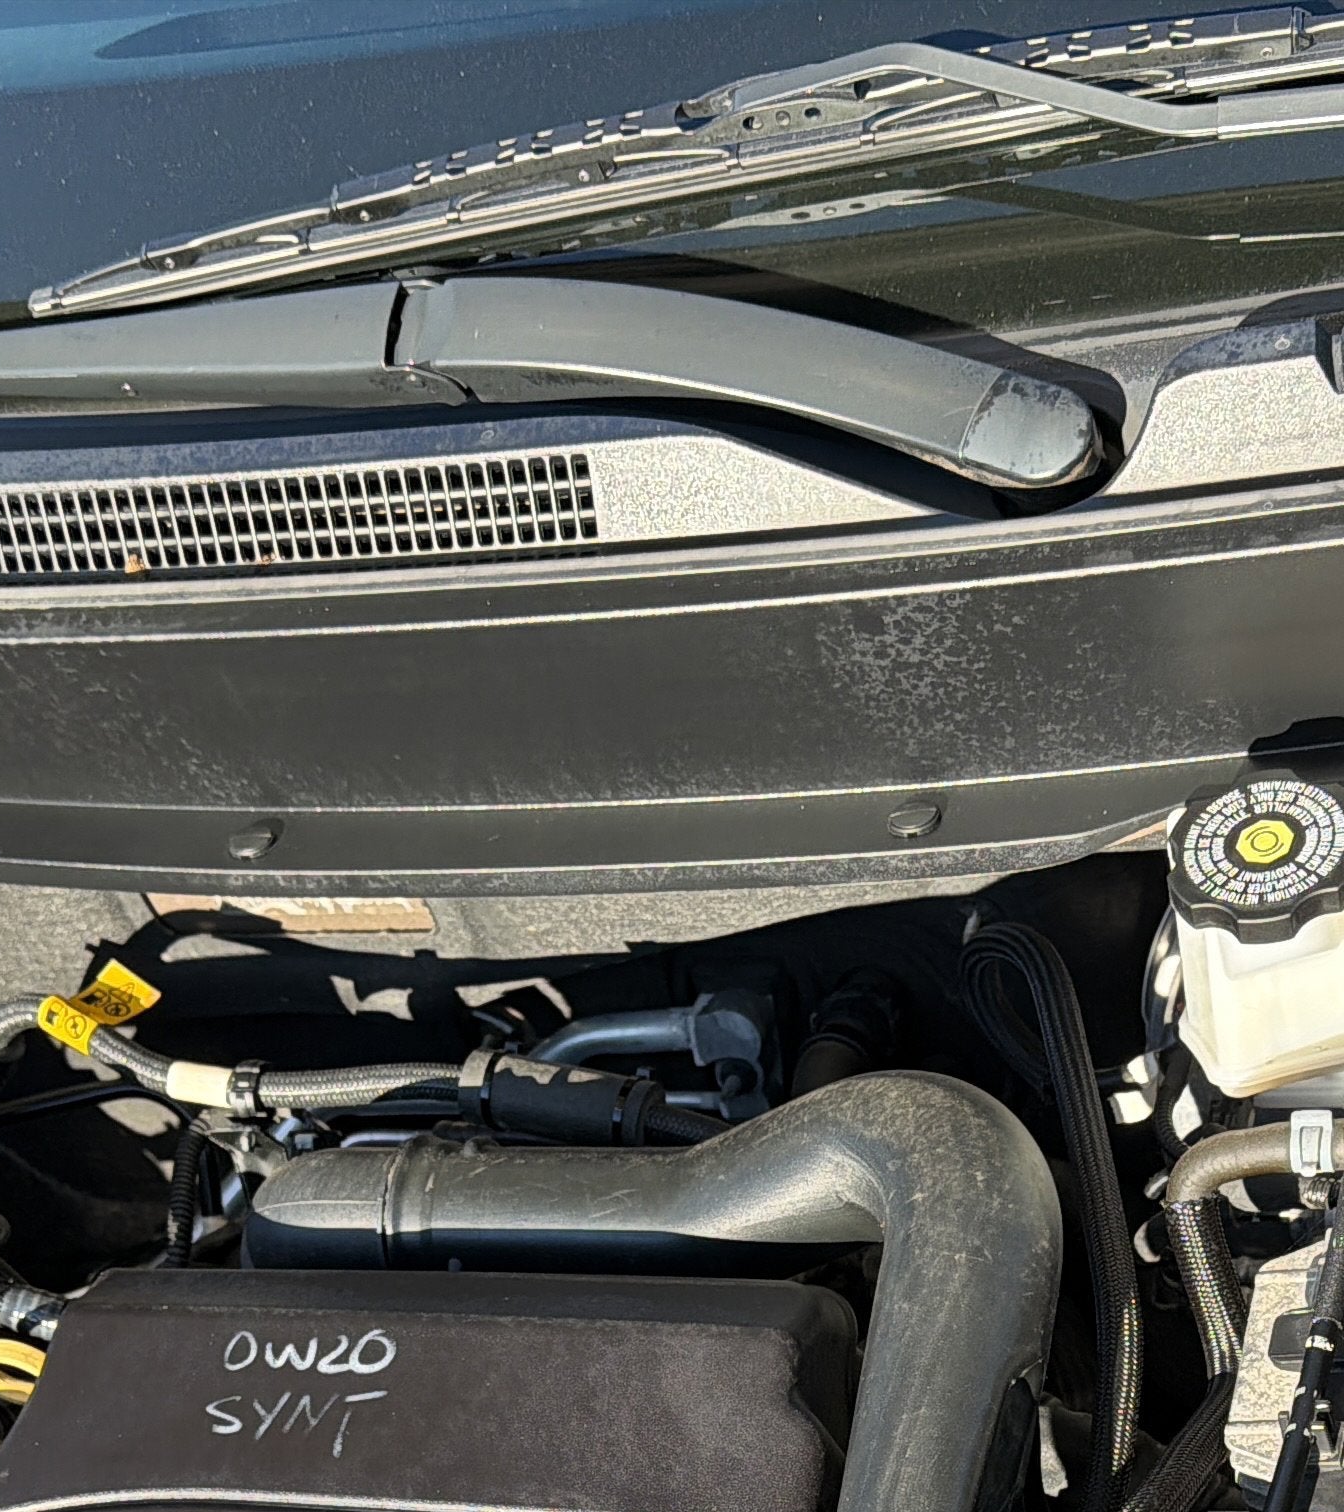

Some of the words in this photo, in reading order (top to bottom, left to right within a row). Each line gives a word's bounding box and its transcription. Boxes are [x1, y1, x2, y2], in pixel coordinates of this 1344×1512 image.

[1250, 792, 1275, 804] ONLY
[1276, 792, 1298, 802] USE
[1304, 783, 1336, 807] SEALED
[1253, 801, 1287, 813] FILLER
[1237, 862, 1297, 882] PROVENANT
[1213, 885, 1259, 905] NETTOYER
[1227, 878, 1246, 892] QUE
[1265, 874, 1318, 903] ATTENTION:
[205, 1388, 389, 1458] SYNT
